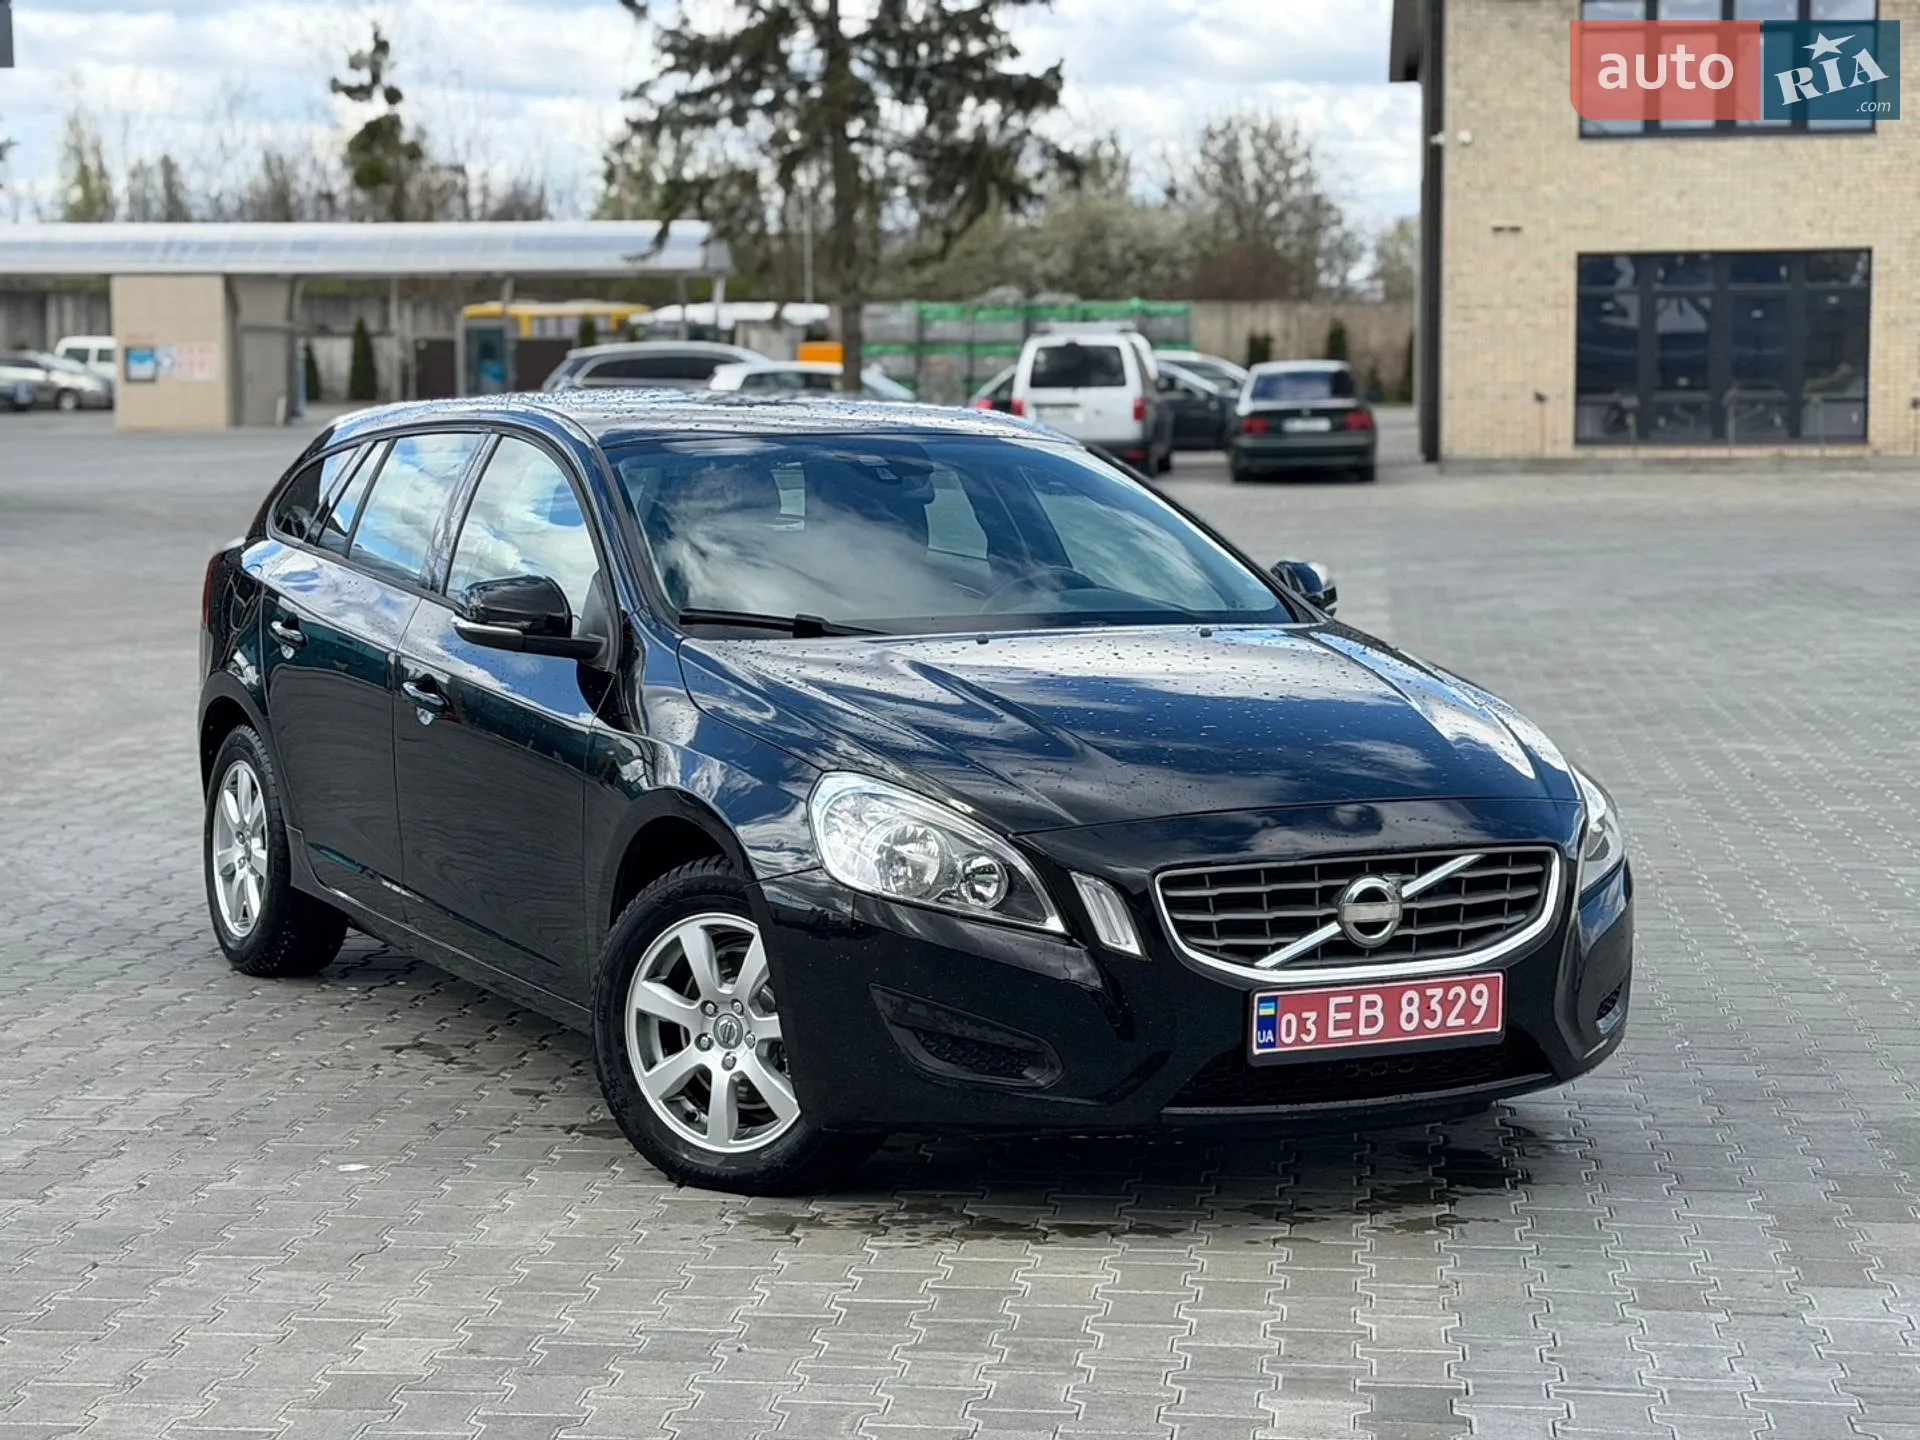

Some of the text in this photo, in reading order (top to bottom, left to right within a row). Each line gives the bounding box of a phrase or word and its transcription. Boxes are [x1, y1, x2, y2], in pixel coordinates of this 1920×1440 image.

[1280, 983, 1489, 1044] 03 EB 8329
[1258, 1029, 1275, 1044] UA
